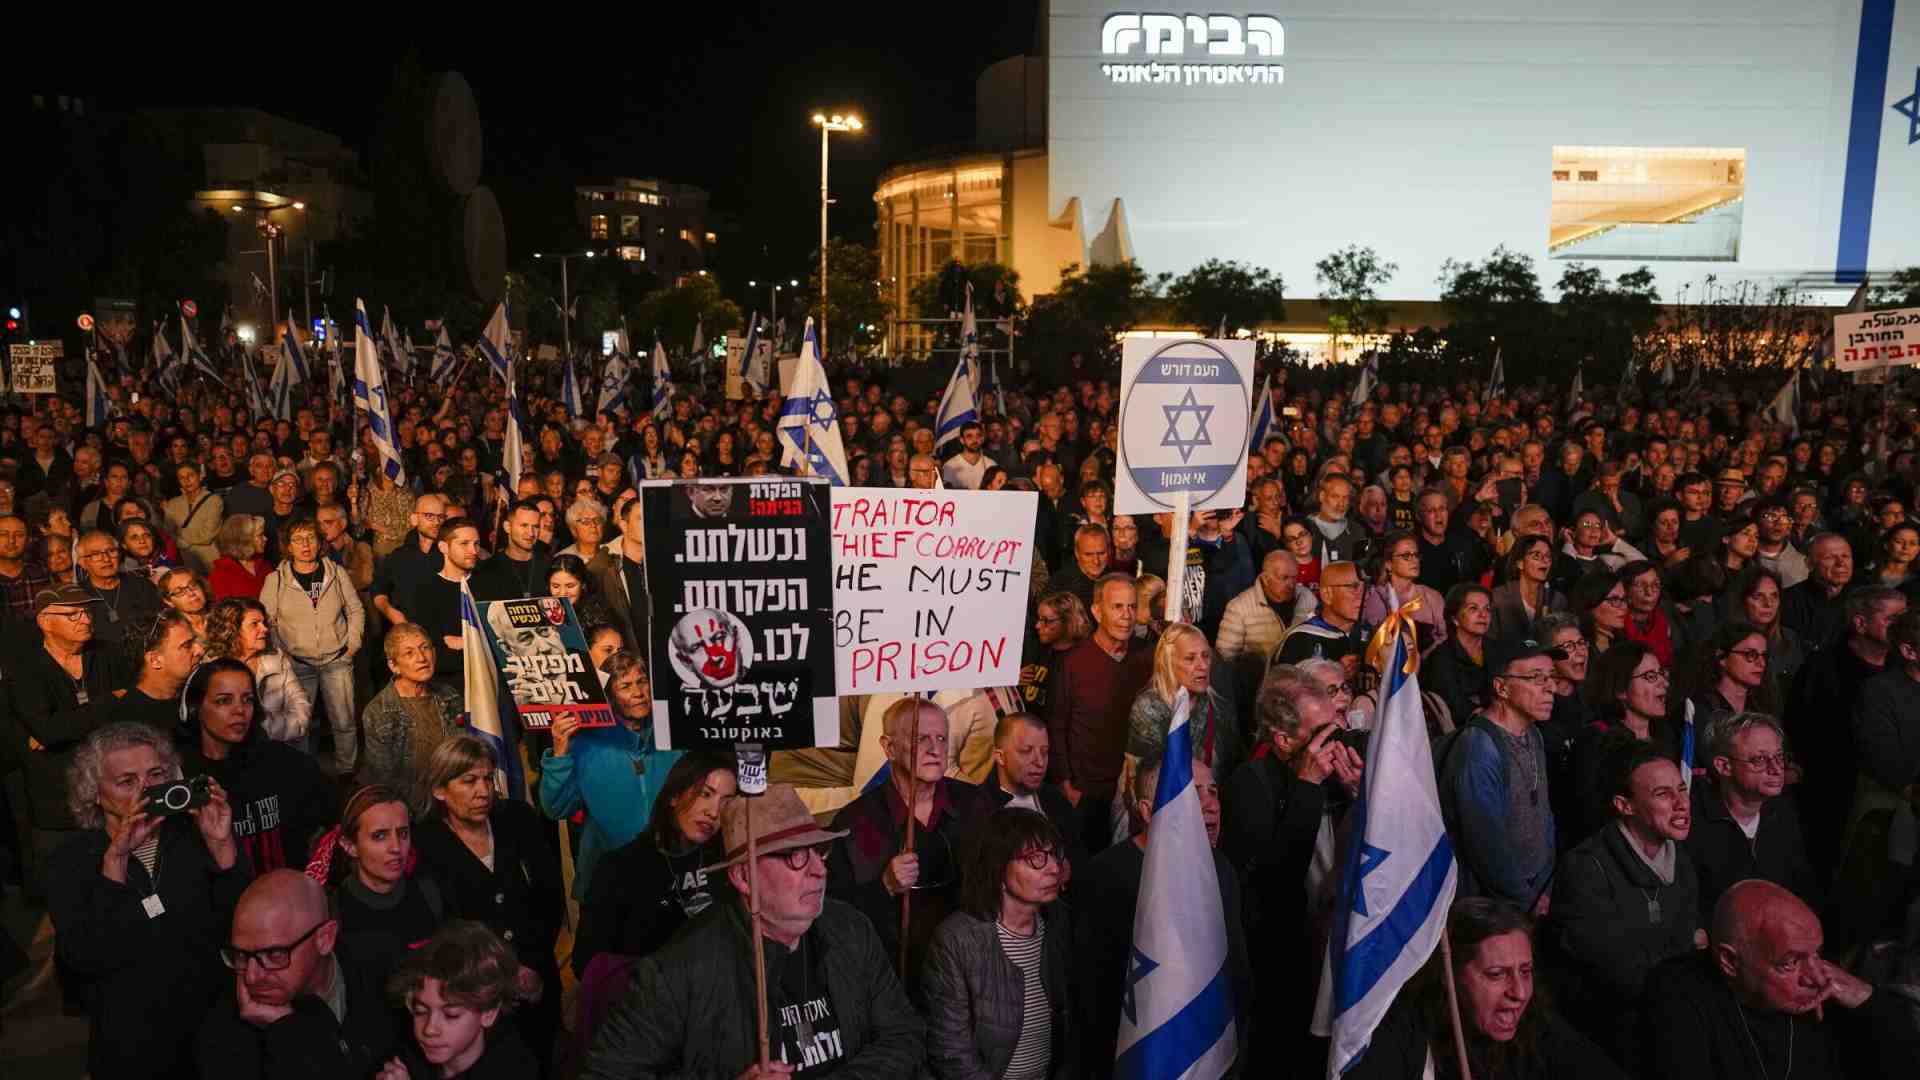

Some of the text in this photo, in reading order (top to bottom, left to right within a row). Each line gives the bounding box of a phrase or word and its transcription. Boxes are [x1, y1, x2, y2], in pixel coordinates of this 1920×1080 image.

[1102, 62, 1284, 86] התיאטרון הלאומי
[1859, 311, 1920, 329] ממשלת
[1848, 330, 1904, 347] החורבן
[1161, 363, 1219, 377] העם דורש
[750, 483, 801, 501] הפקרת
[1161, 472, 1207, 488] אי אמון!
[833, 499, 955, 529] TRAITOR
[674, 523, 806, 562] נכשלתם.
[916, 532, 1022, 564] CORRUPT
[836, 563, 1021, 596] HE MUST
[673, 578, 808, 616] הפקרתם.
[507, 604, 539, 615] הדחה
[511, 614, 542, 624] עכשיו
[835, 605, 954, 648] BE IN
[753, 622, 810, 662] לכו.
[505, 653, 586, 680] מפקיר
[852, 636, 1006, 688] PRISON
[522, 711, 552, 726] יותר
[700, 726, 784, 742] באוקטובר
